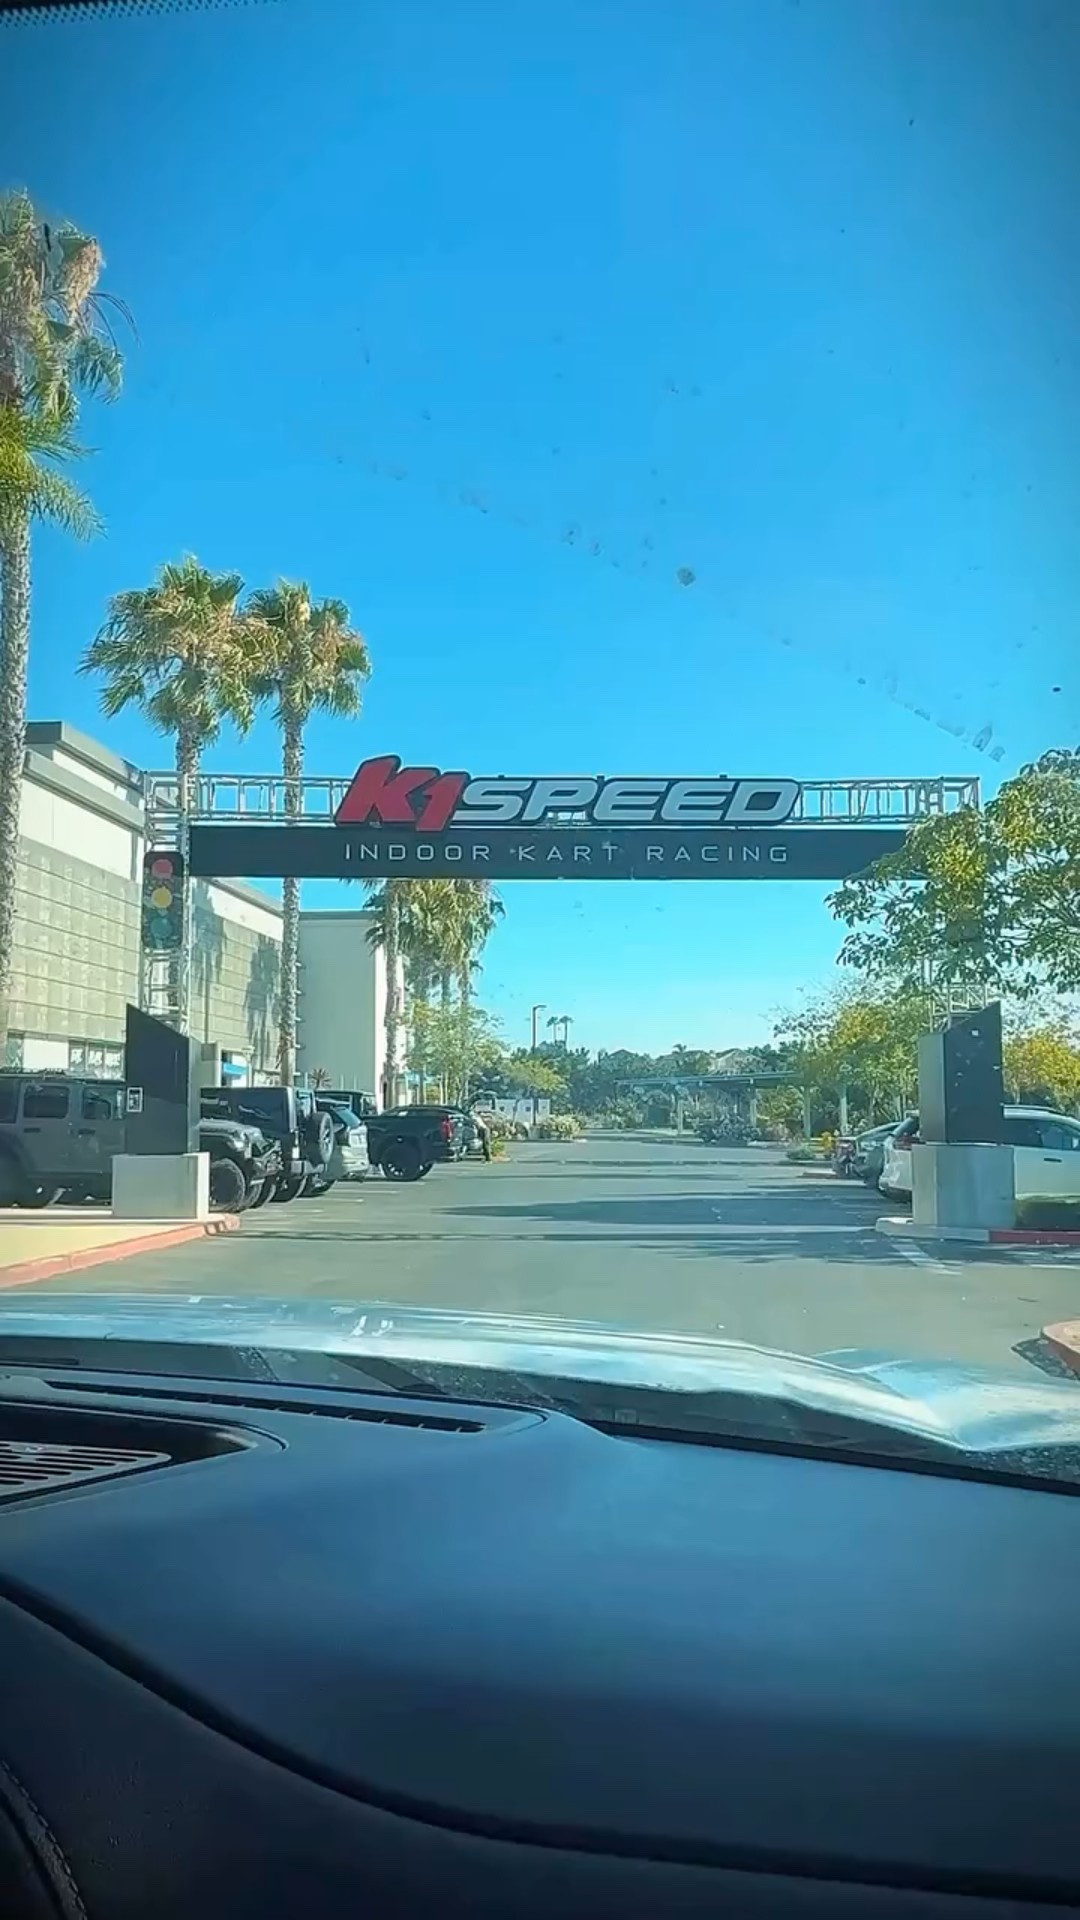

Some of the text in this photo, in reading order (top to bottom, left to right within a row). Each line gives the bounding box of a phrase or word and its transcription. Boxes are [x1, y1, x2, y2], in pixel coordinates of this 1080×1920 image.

[452, 780, 799, 820] SPEED
[344, 843, 789, 863] INDOOR KART RACING
